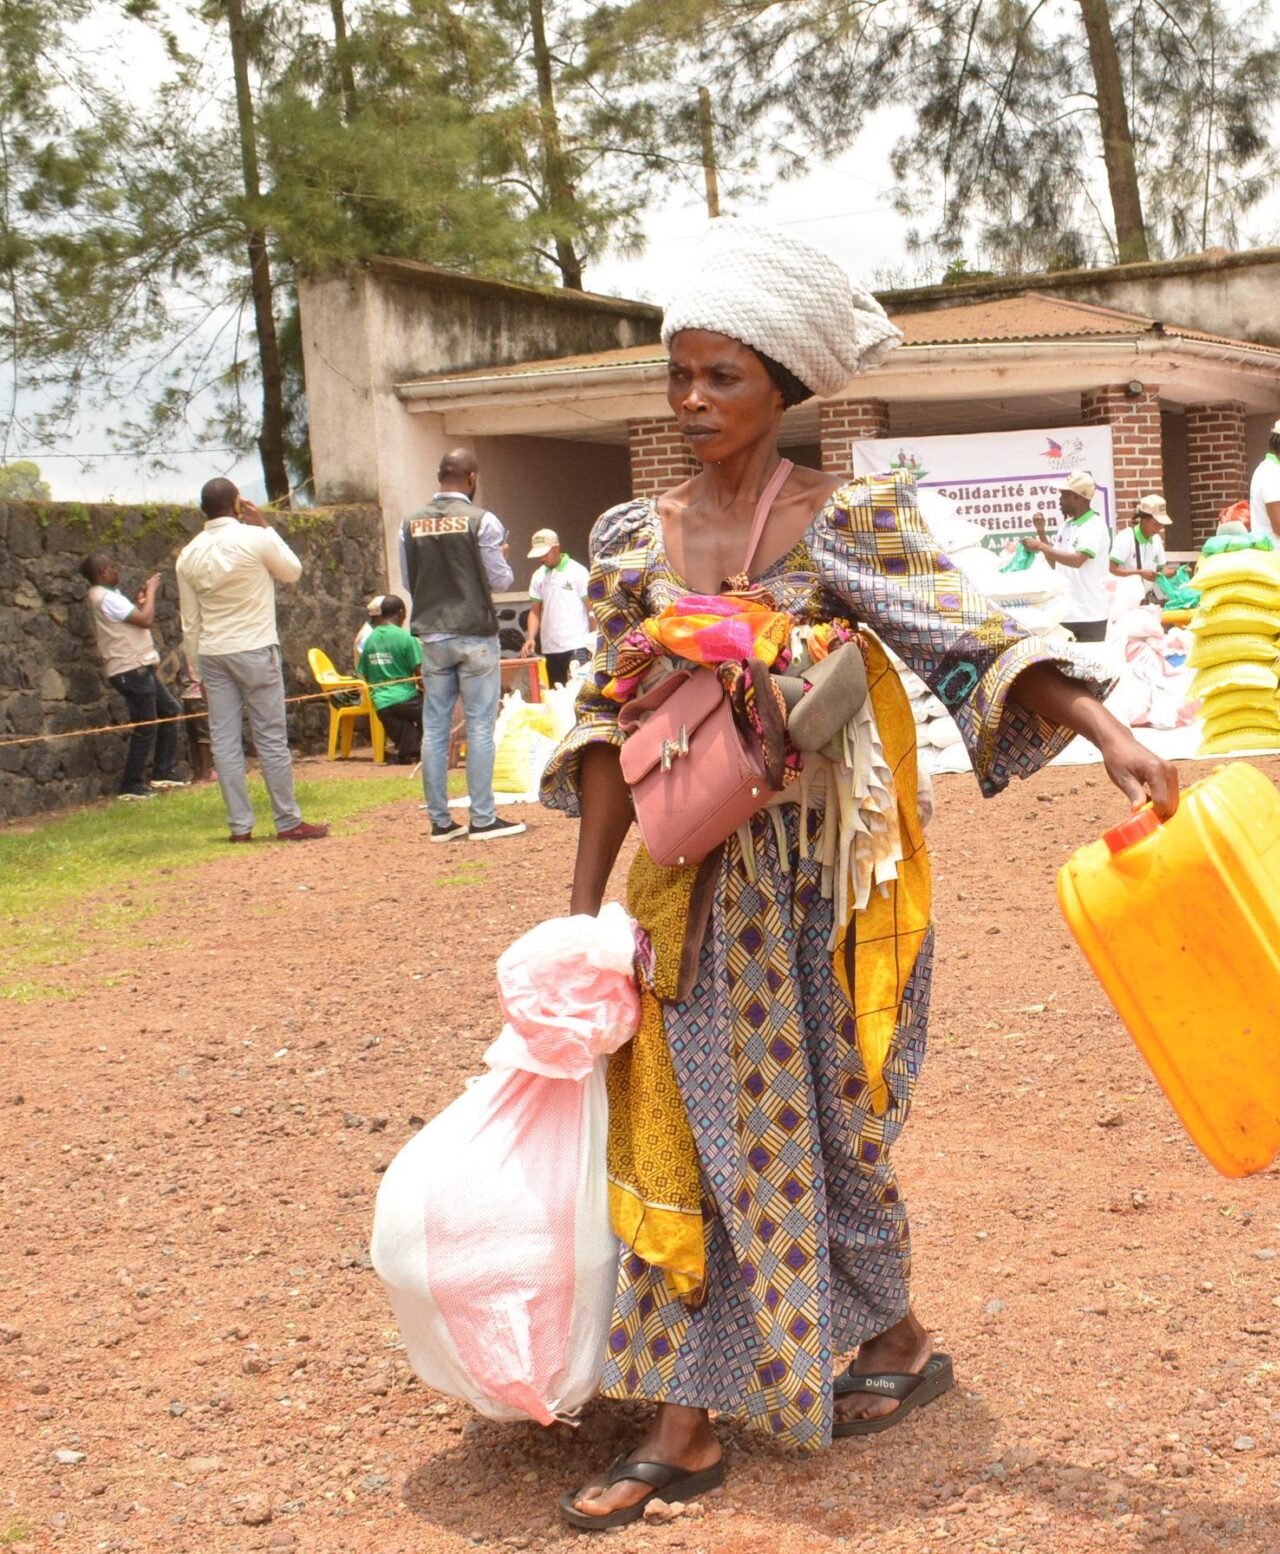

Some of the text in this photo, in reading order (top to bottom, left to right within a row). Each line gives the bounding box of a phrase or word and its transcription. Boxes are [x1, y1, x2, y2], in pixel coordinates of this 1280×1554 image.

[1030, 486, 1057, 495] ave
[956, 500, 1056, 515] ersonnes en
[412, 518, 467, 533] PRESS
